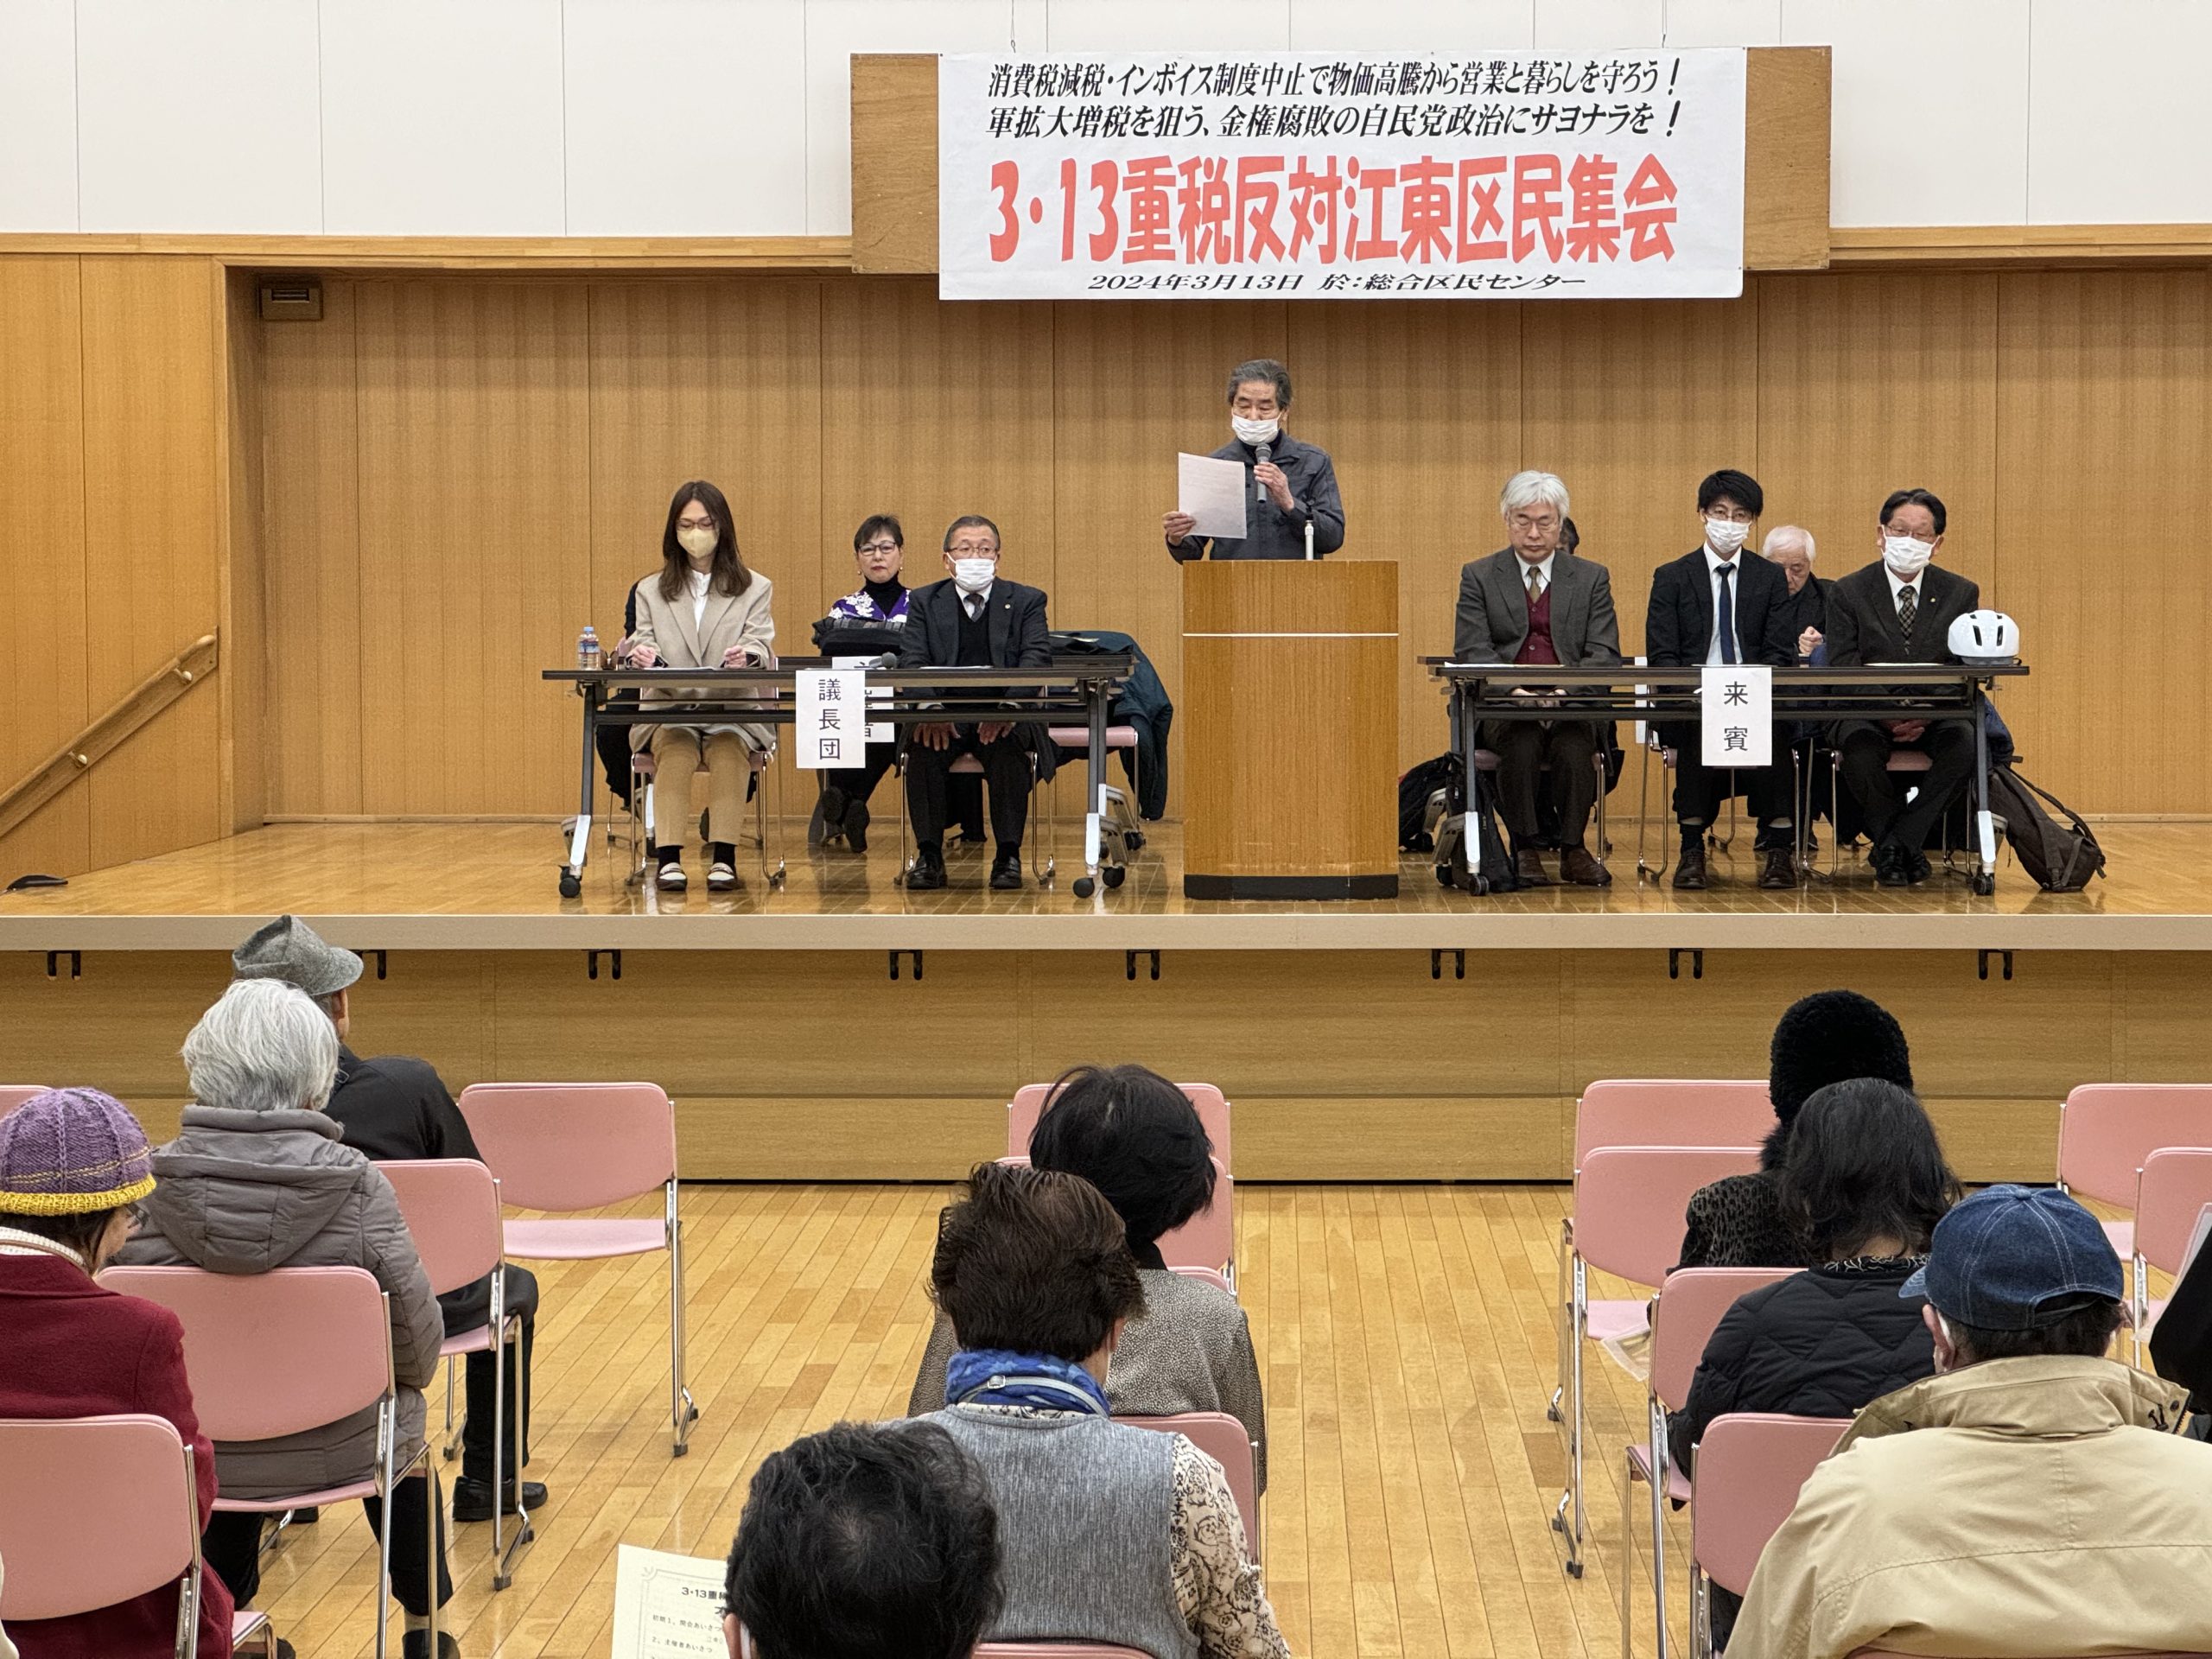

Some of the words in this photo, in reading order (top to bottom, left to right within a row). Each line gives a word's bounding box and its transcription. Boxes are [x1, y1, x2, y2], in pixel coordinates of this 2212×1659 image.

[1087, 273, 1305, 291] 2024年3月13日
[817, 677, 842, 760] 議長団
[1723, 681, 1748, 752] 来賓
